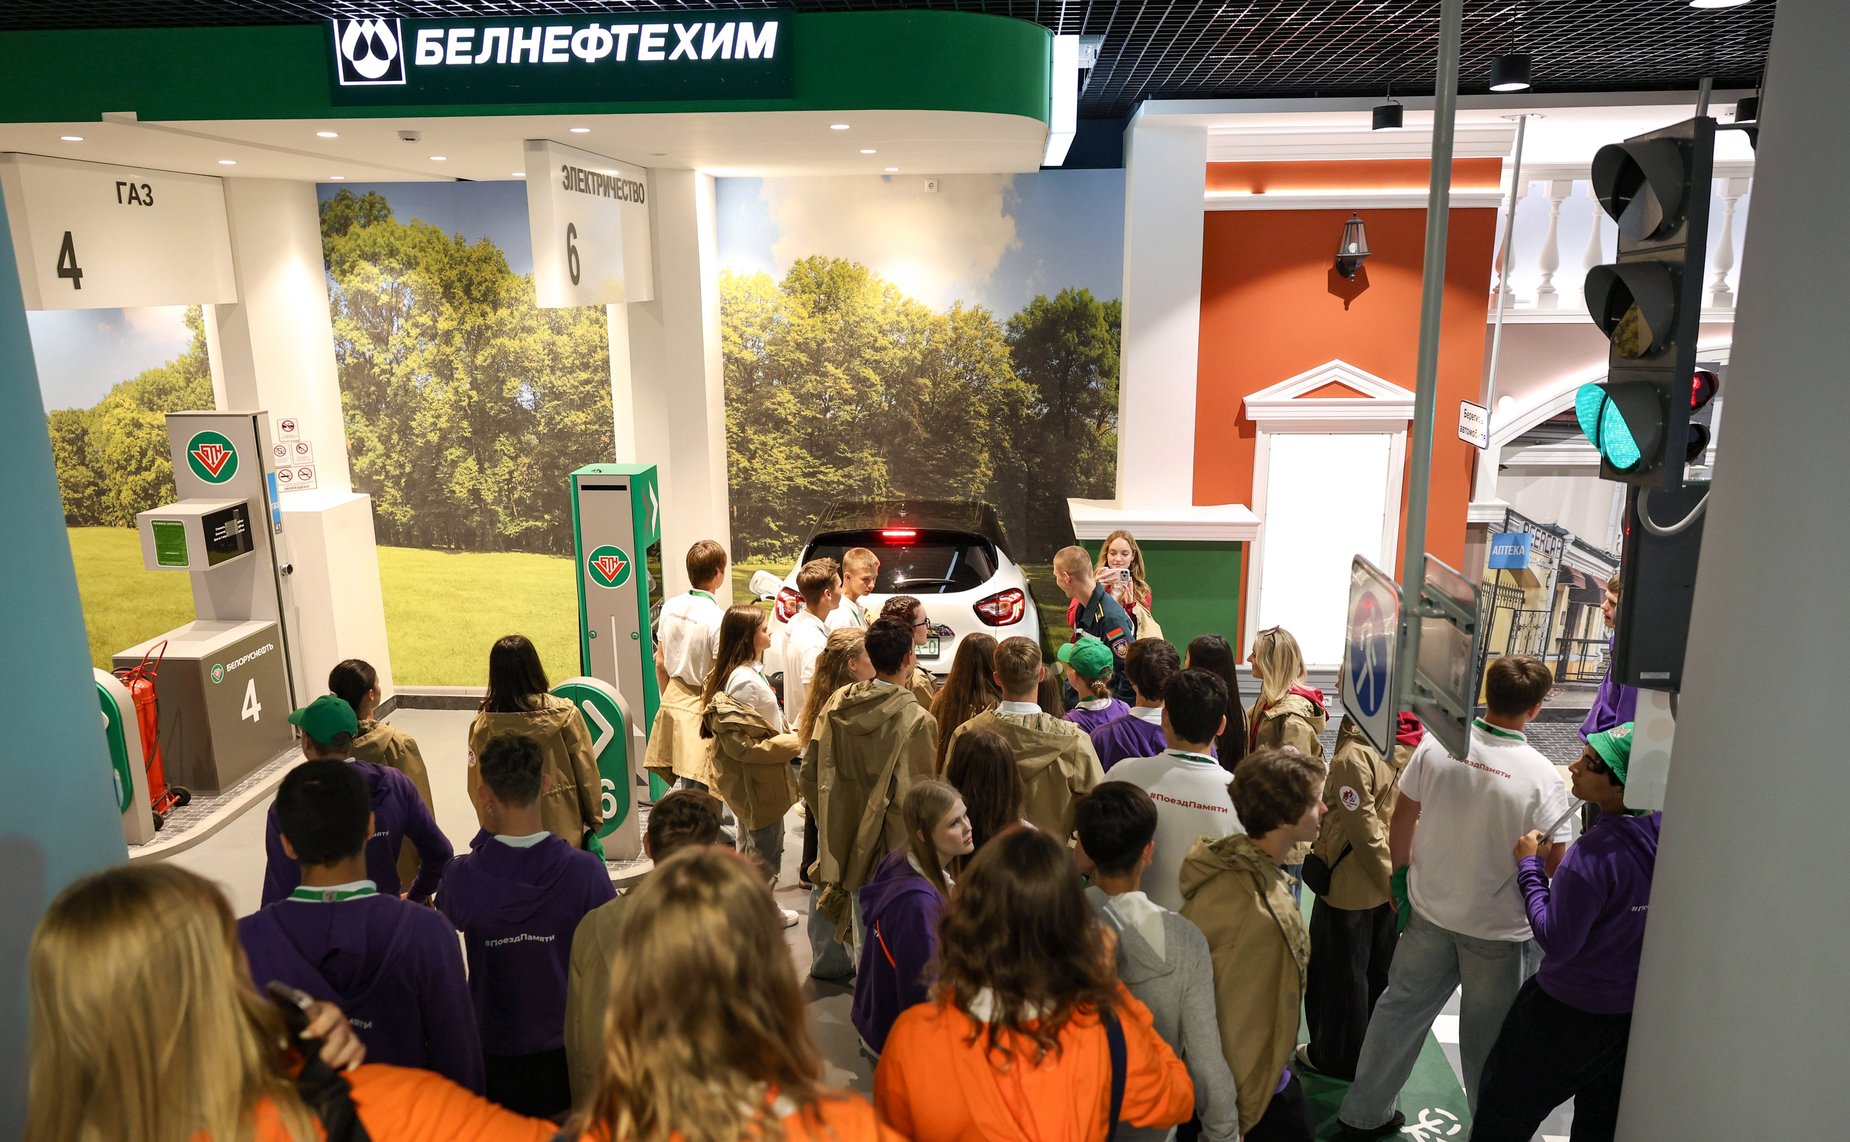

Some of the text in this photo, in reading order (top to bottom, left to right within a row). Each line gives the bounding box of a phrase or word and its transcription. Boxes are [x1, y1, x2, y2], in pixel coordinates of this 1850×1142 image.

[415, 21, 779, 65] БЕЛНЕФТЕХИМ
[116, 181, 154, 207] ГАЗ
[562, 164, 645, 204] ЭЛЕКТРИЧЕСТВО
[57, 231, 83, 290] 4
[566, 222, 581, 286] 6
[1492, 544, 1526, 556] АПТЕКА
[226, 643, 274, 672] БЕЛОРУСНЕФТЬ
[241, 678, 262, 723] 4
[600, 778, 618, 819] 6
[1150, 792, 1228, 813] #ПоездПамяти
